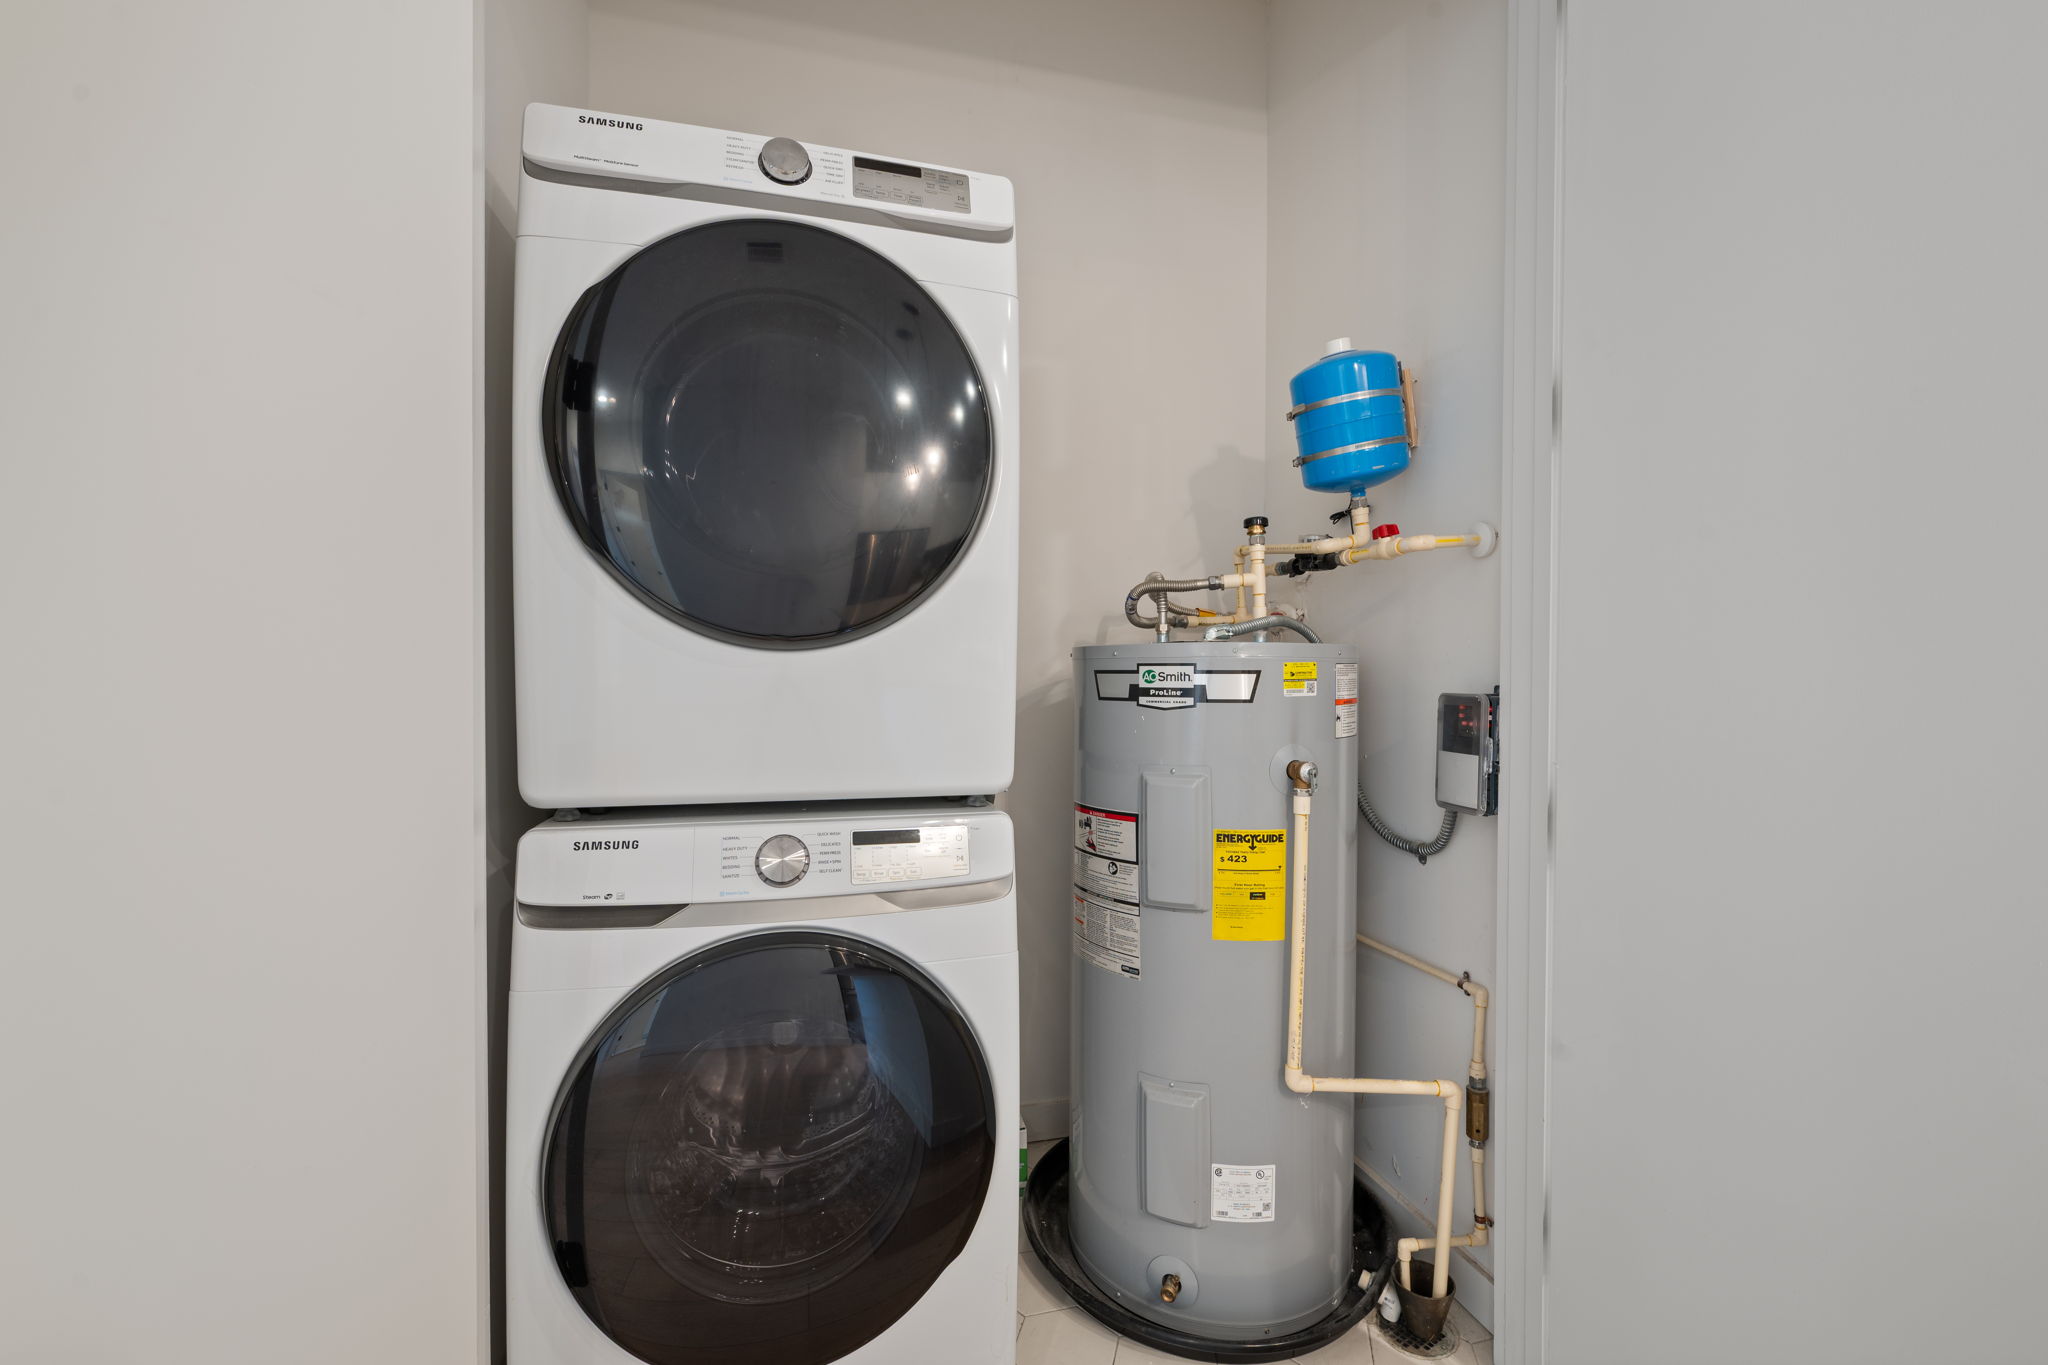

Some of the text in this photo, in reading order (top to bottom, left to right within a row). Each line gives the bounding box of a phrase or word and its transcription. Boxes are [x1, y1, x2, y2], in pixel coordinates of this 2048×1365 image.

[578, 115, 643, 131] SAMSUNG
[1158, 672, 1191, 682] Smith
[1216, 833, 1284, 845] ENERGYGUIDE
[573, 840, 639, 851] SAMSUNG
[1227, 855, 1248, 863] 423
